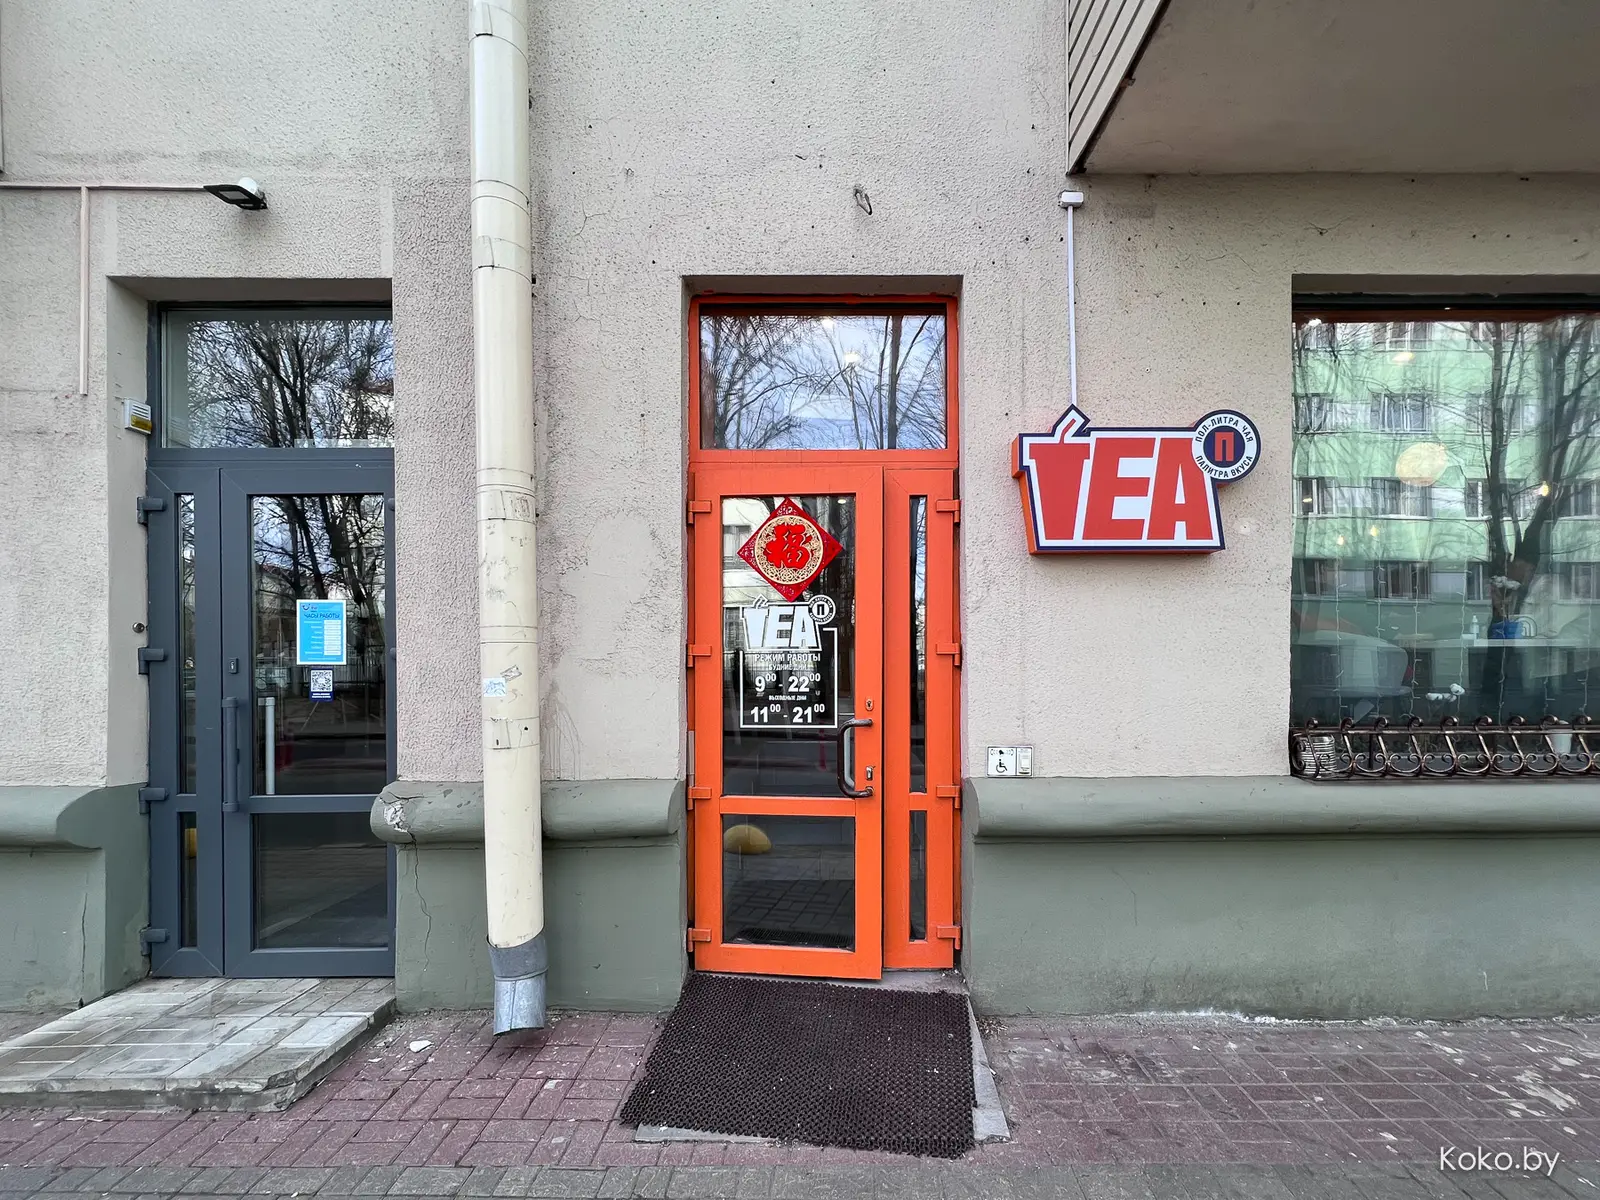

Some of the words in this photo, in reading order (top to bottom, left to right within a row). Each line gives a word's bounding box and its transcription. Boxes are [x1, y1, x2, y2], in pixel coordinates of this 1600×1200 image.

[1195, 416, 1239, 443] ПОЛ-ЛИТРА
[1242, 425, 1254, 443] ЧАЯ
[1214, 431, 1235, 462] П
[1195, 455, 1229, 478] ПАЛИТРА
[1231, 456, 1253, 476] ВКУСА
[755, 653, 785, 661] РЕЖИМ
[787, 653, 821, 661] РАБОТЫ
